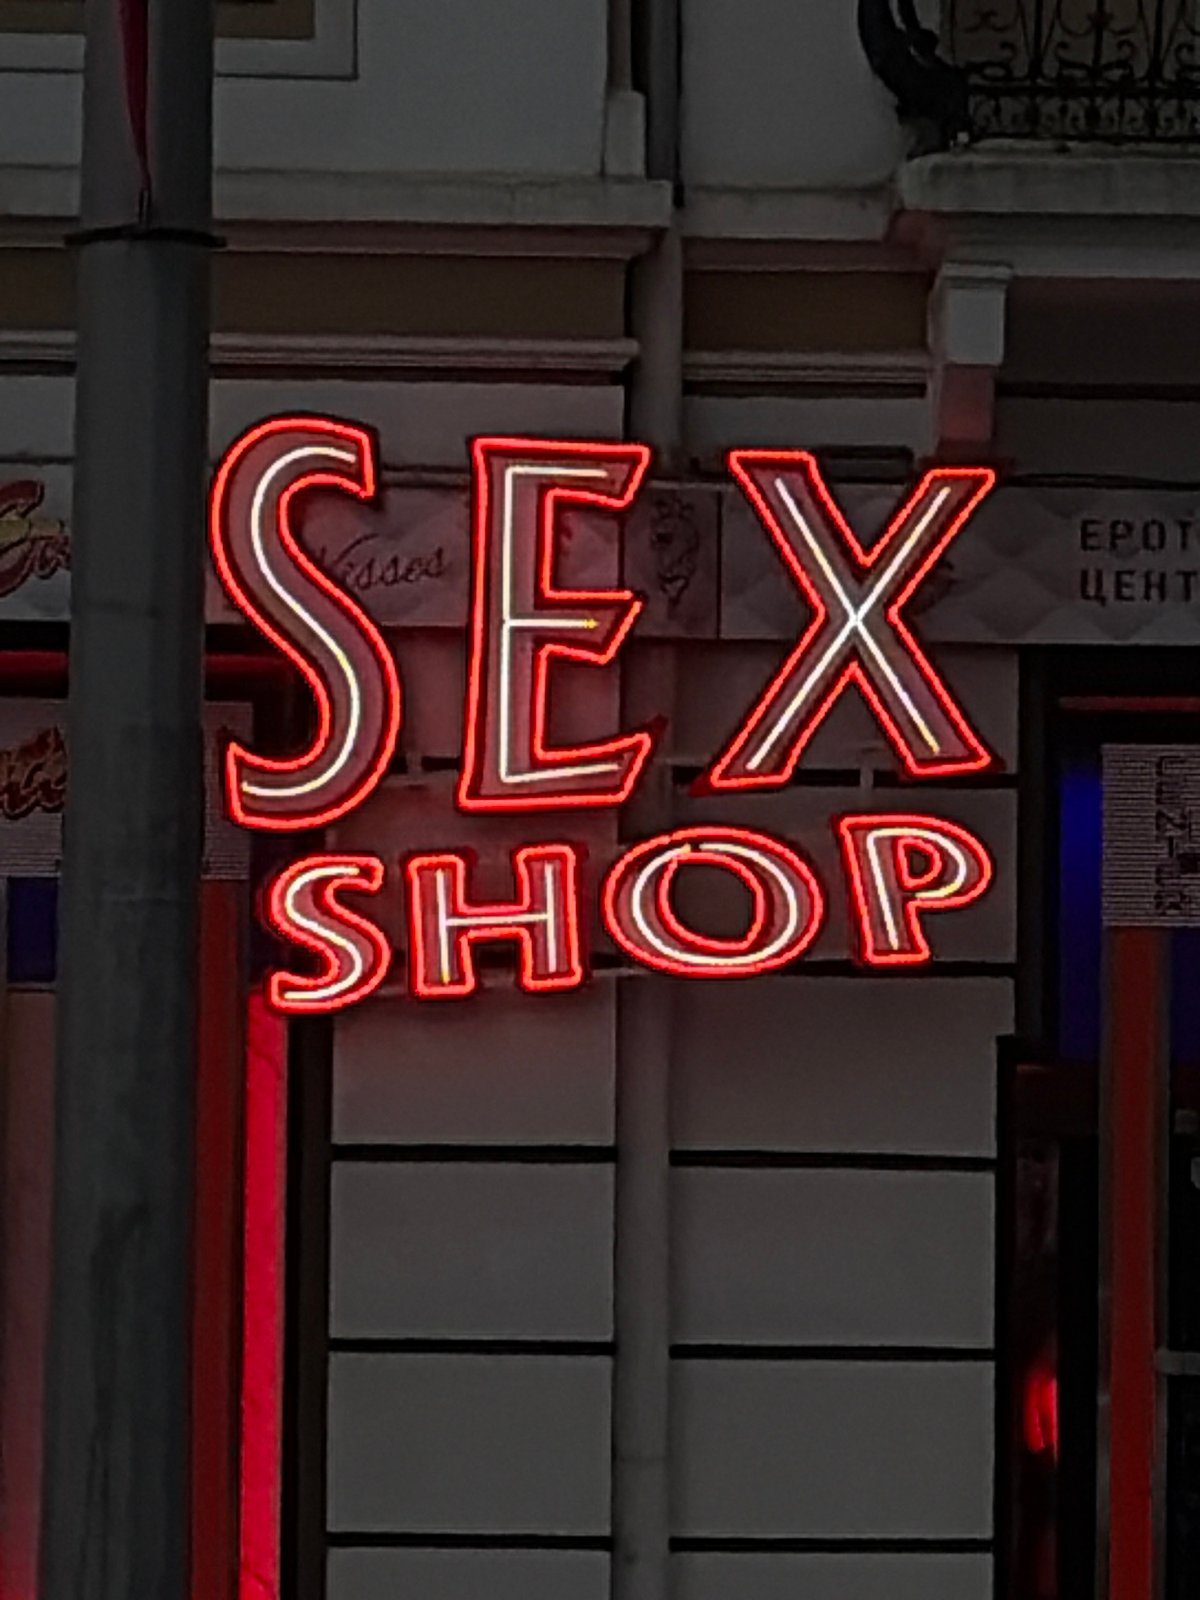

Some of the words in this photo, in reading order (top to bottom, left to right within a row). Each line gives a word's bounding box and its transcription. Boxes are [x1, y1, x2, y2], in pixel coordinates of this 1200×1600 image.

[211, 418, 996, 830] SEX
[1081, 568, 1198, 608] ЦЕНТ
[269, 814, 992, 1013] SHOP
